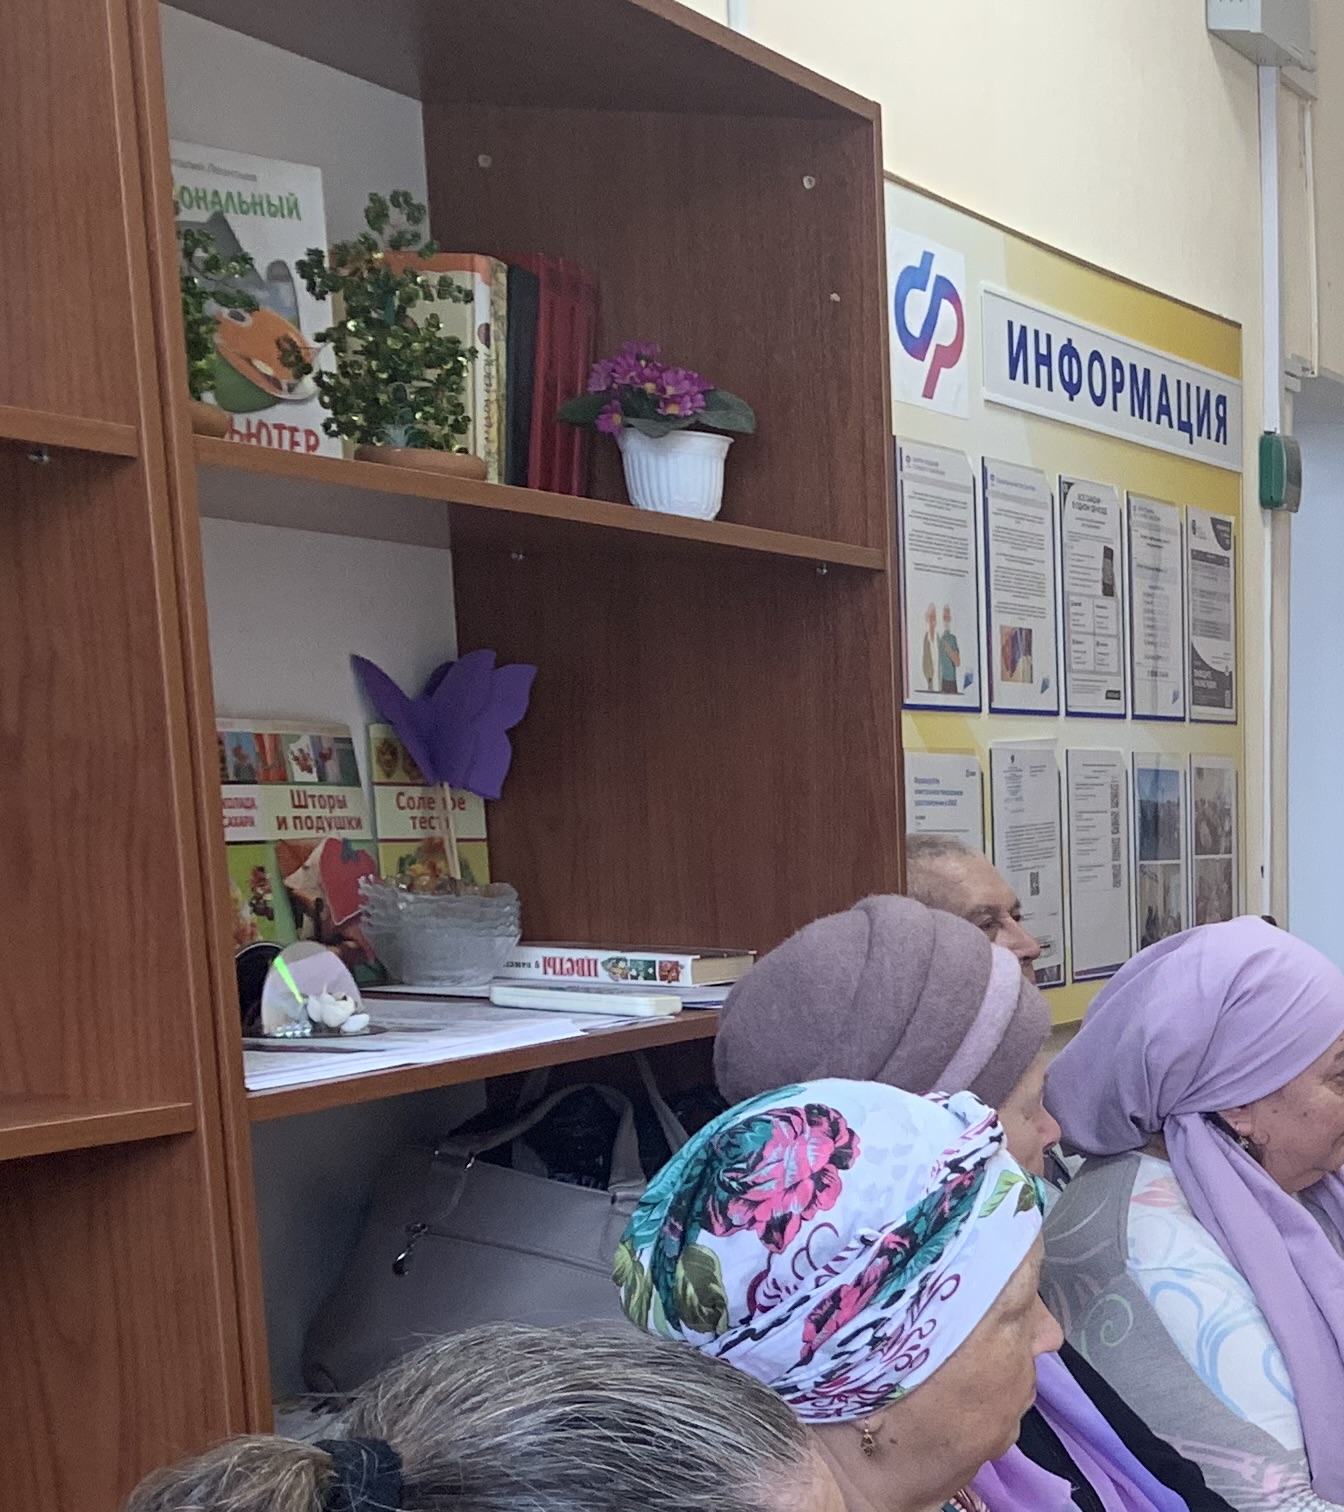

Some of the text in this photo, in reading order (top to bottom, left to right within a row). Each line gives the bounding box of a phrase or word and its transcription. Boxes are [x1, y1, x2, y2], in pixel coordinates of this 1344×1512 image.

[1007, 320, 1227, 445] ИНФОРМАЦИЯ
[289, 789, 347, 813] Шторы
[276, 815, 362, 833] и подушки
